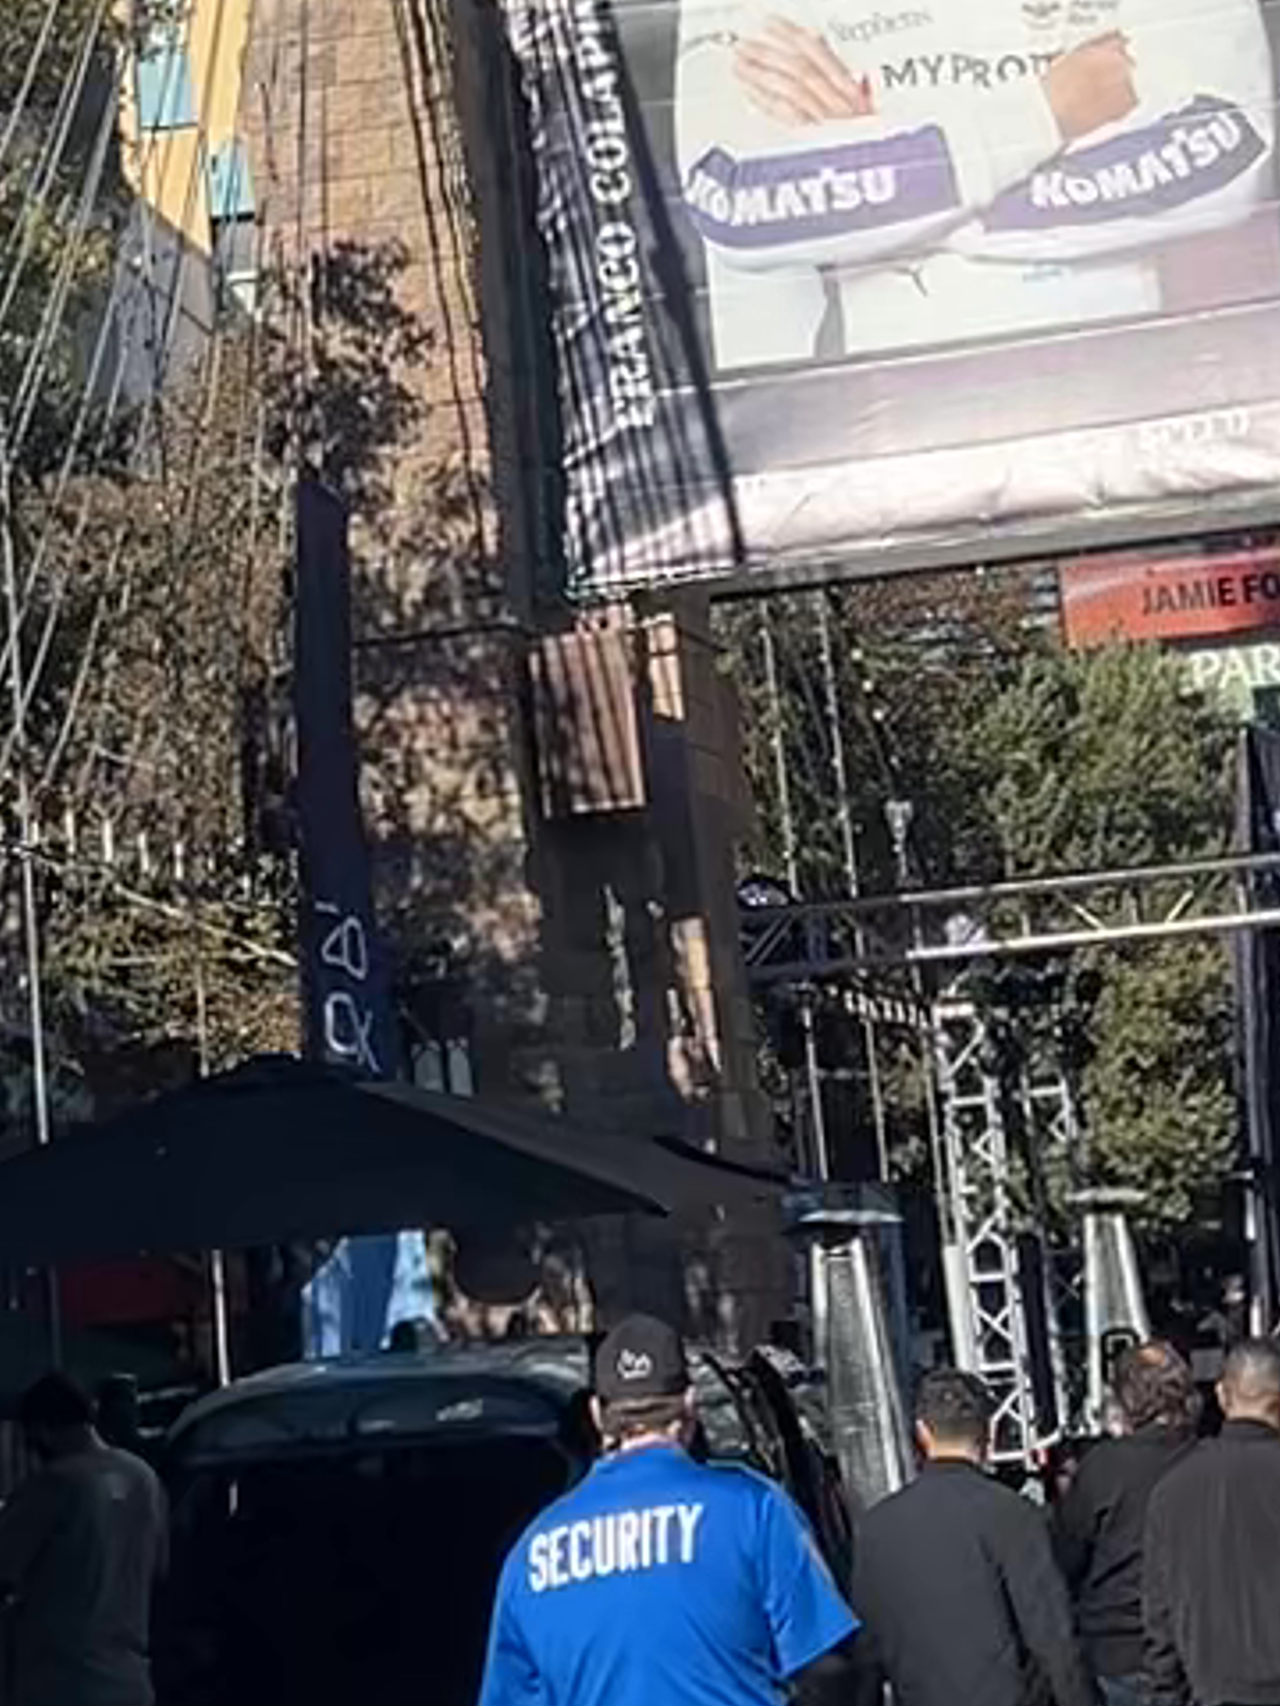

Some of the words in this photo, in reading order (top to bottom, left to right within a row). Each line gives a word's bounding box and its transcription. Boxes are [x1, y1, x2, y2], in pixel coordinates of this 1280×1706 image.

[880, 52, 1054, 87] MYPROT
[1142, 576, 1236, 617] JAMIE
[528, 1502, 703, 1593] SECURITY
